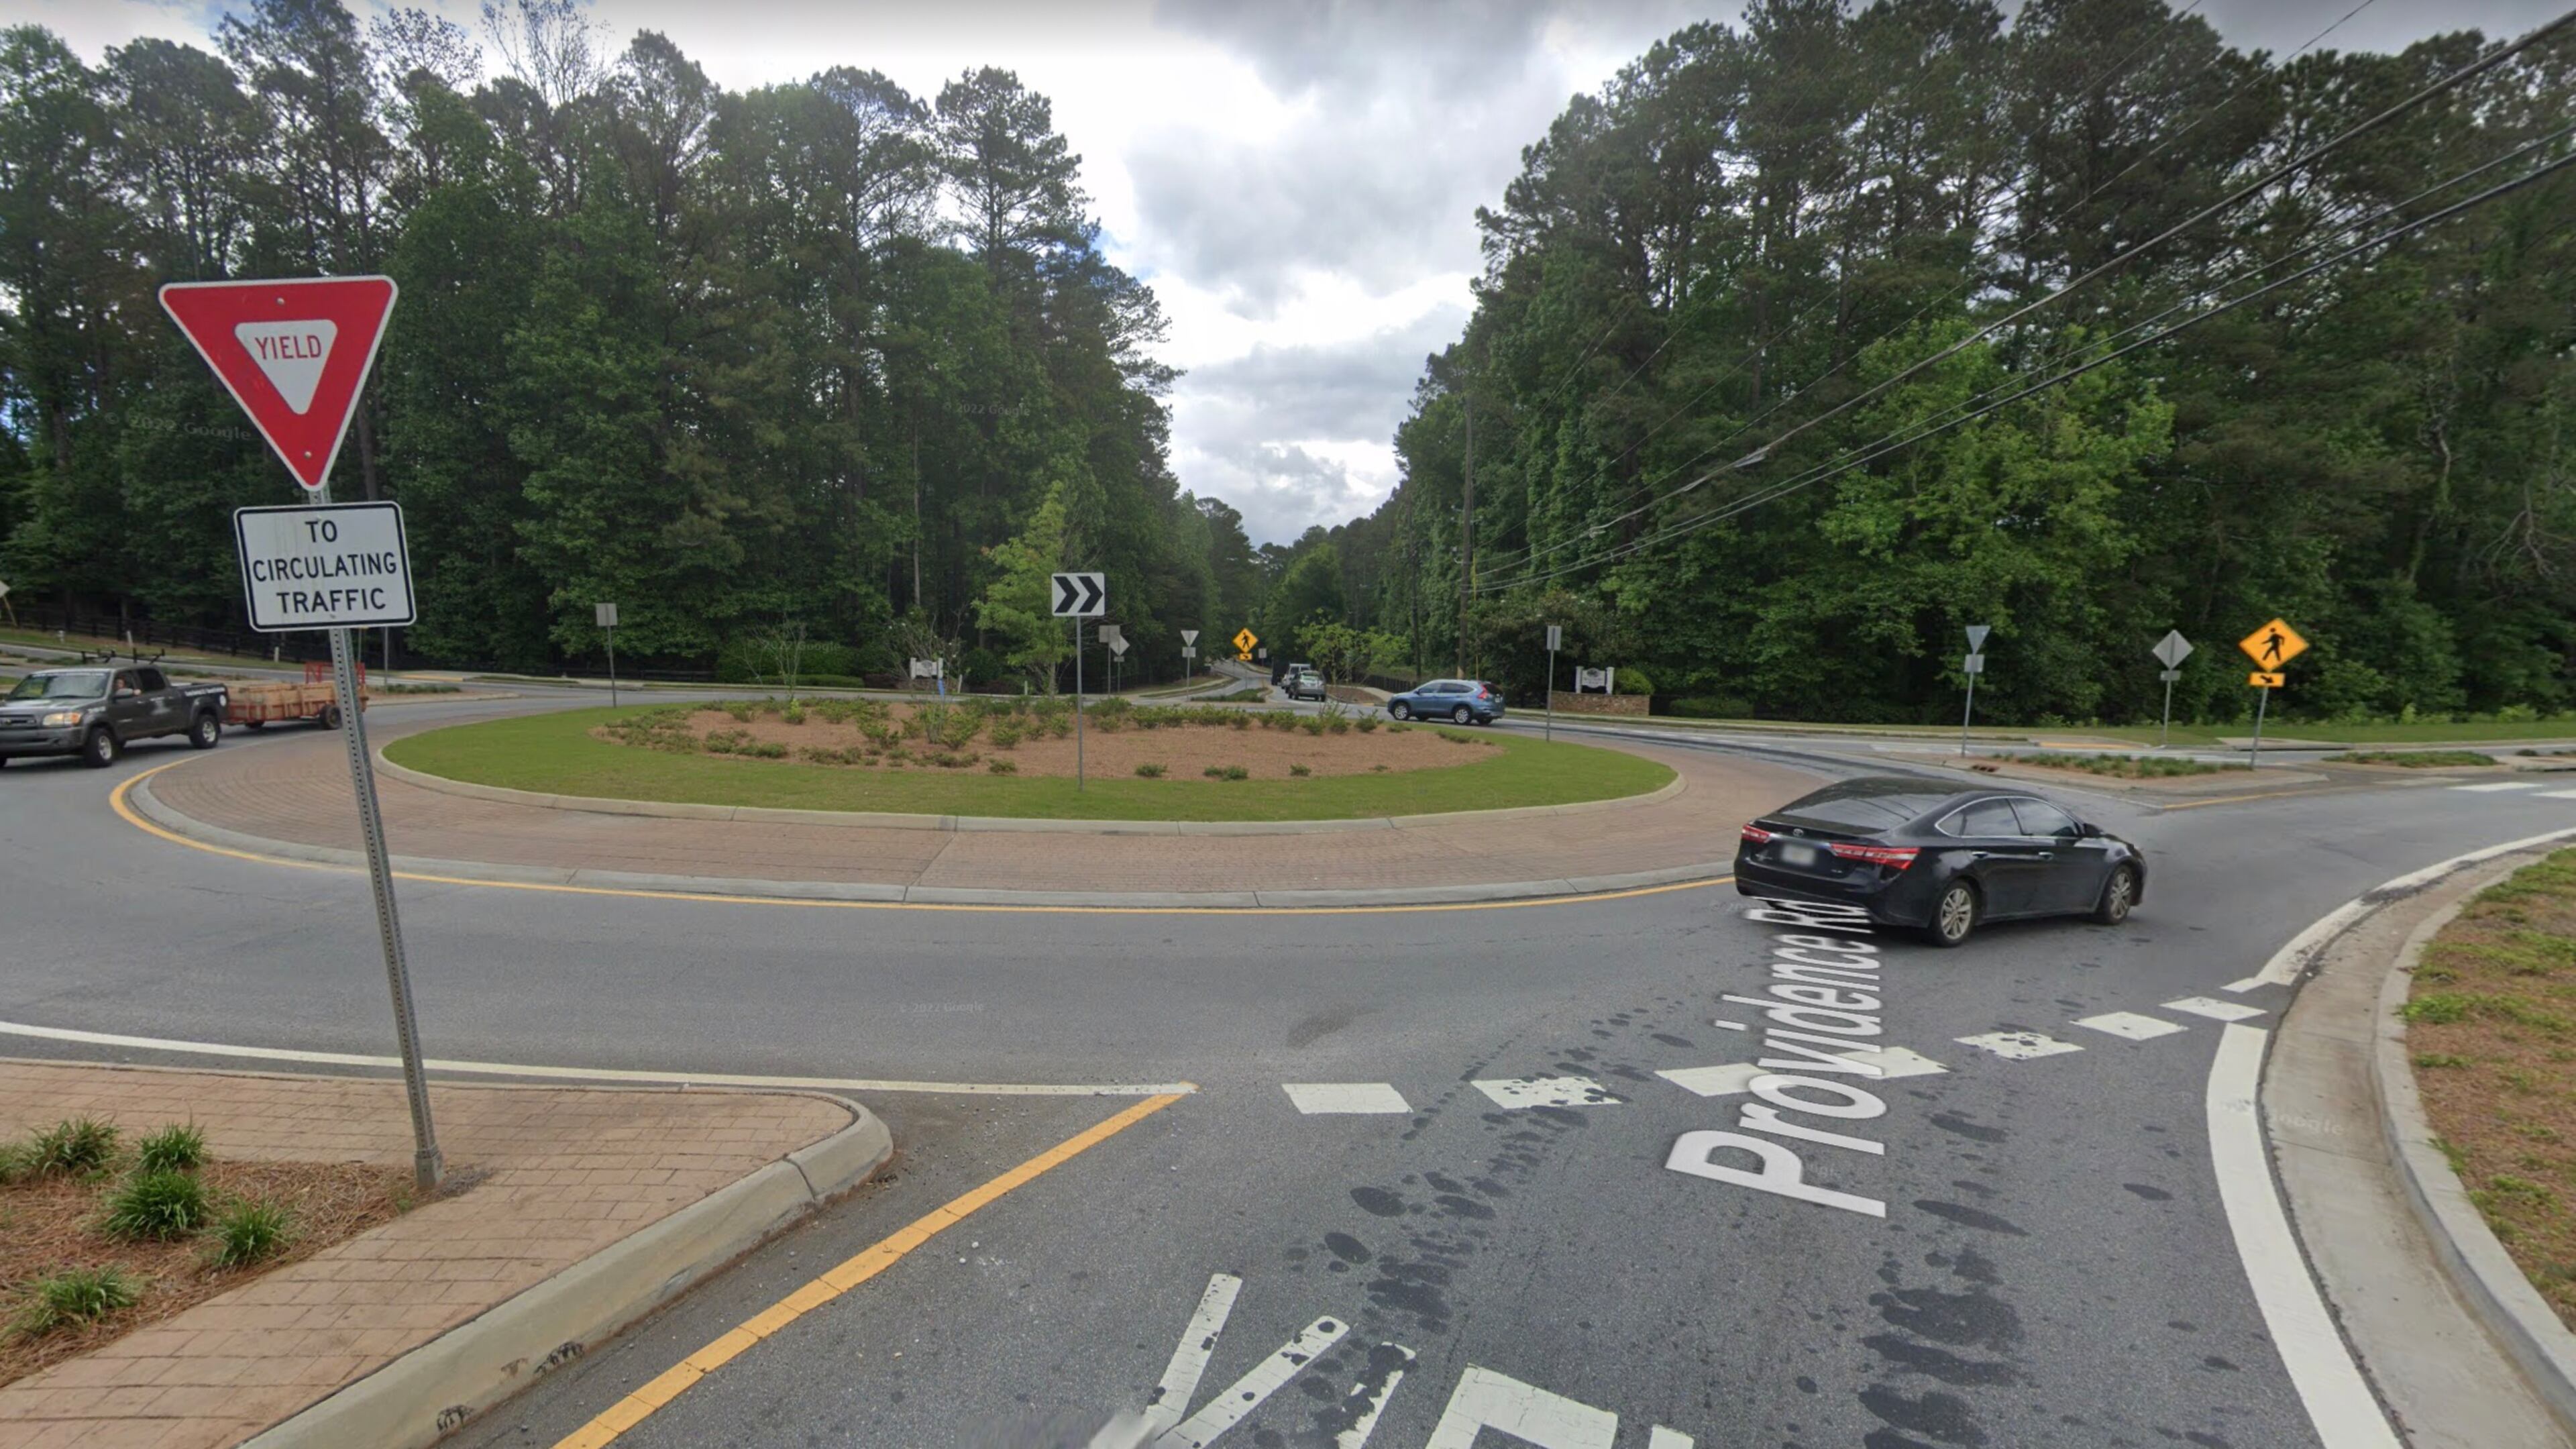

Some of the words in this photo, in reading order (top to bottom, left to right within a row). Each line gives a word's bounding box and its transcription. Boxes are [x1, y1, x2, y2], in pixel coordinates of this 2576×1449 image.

[255, 335, 322, 360] YIELD
[305, 520, 338, 543] TO
[253, 552, 397, 582] CIRCULATING
[276, 588, 386, 614] TRAFFIC
